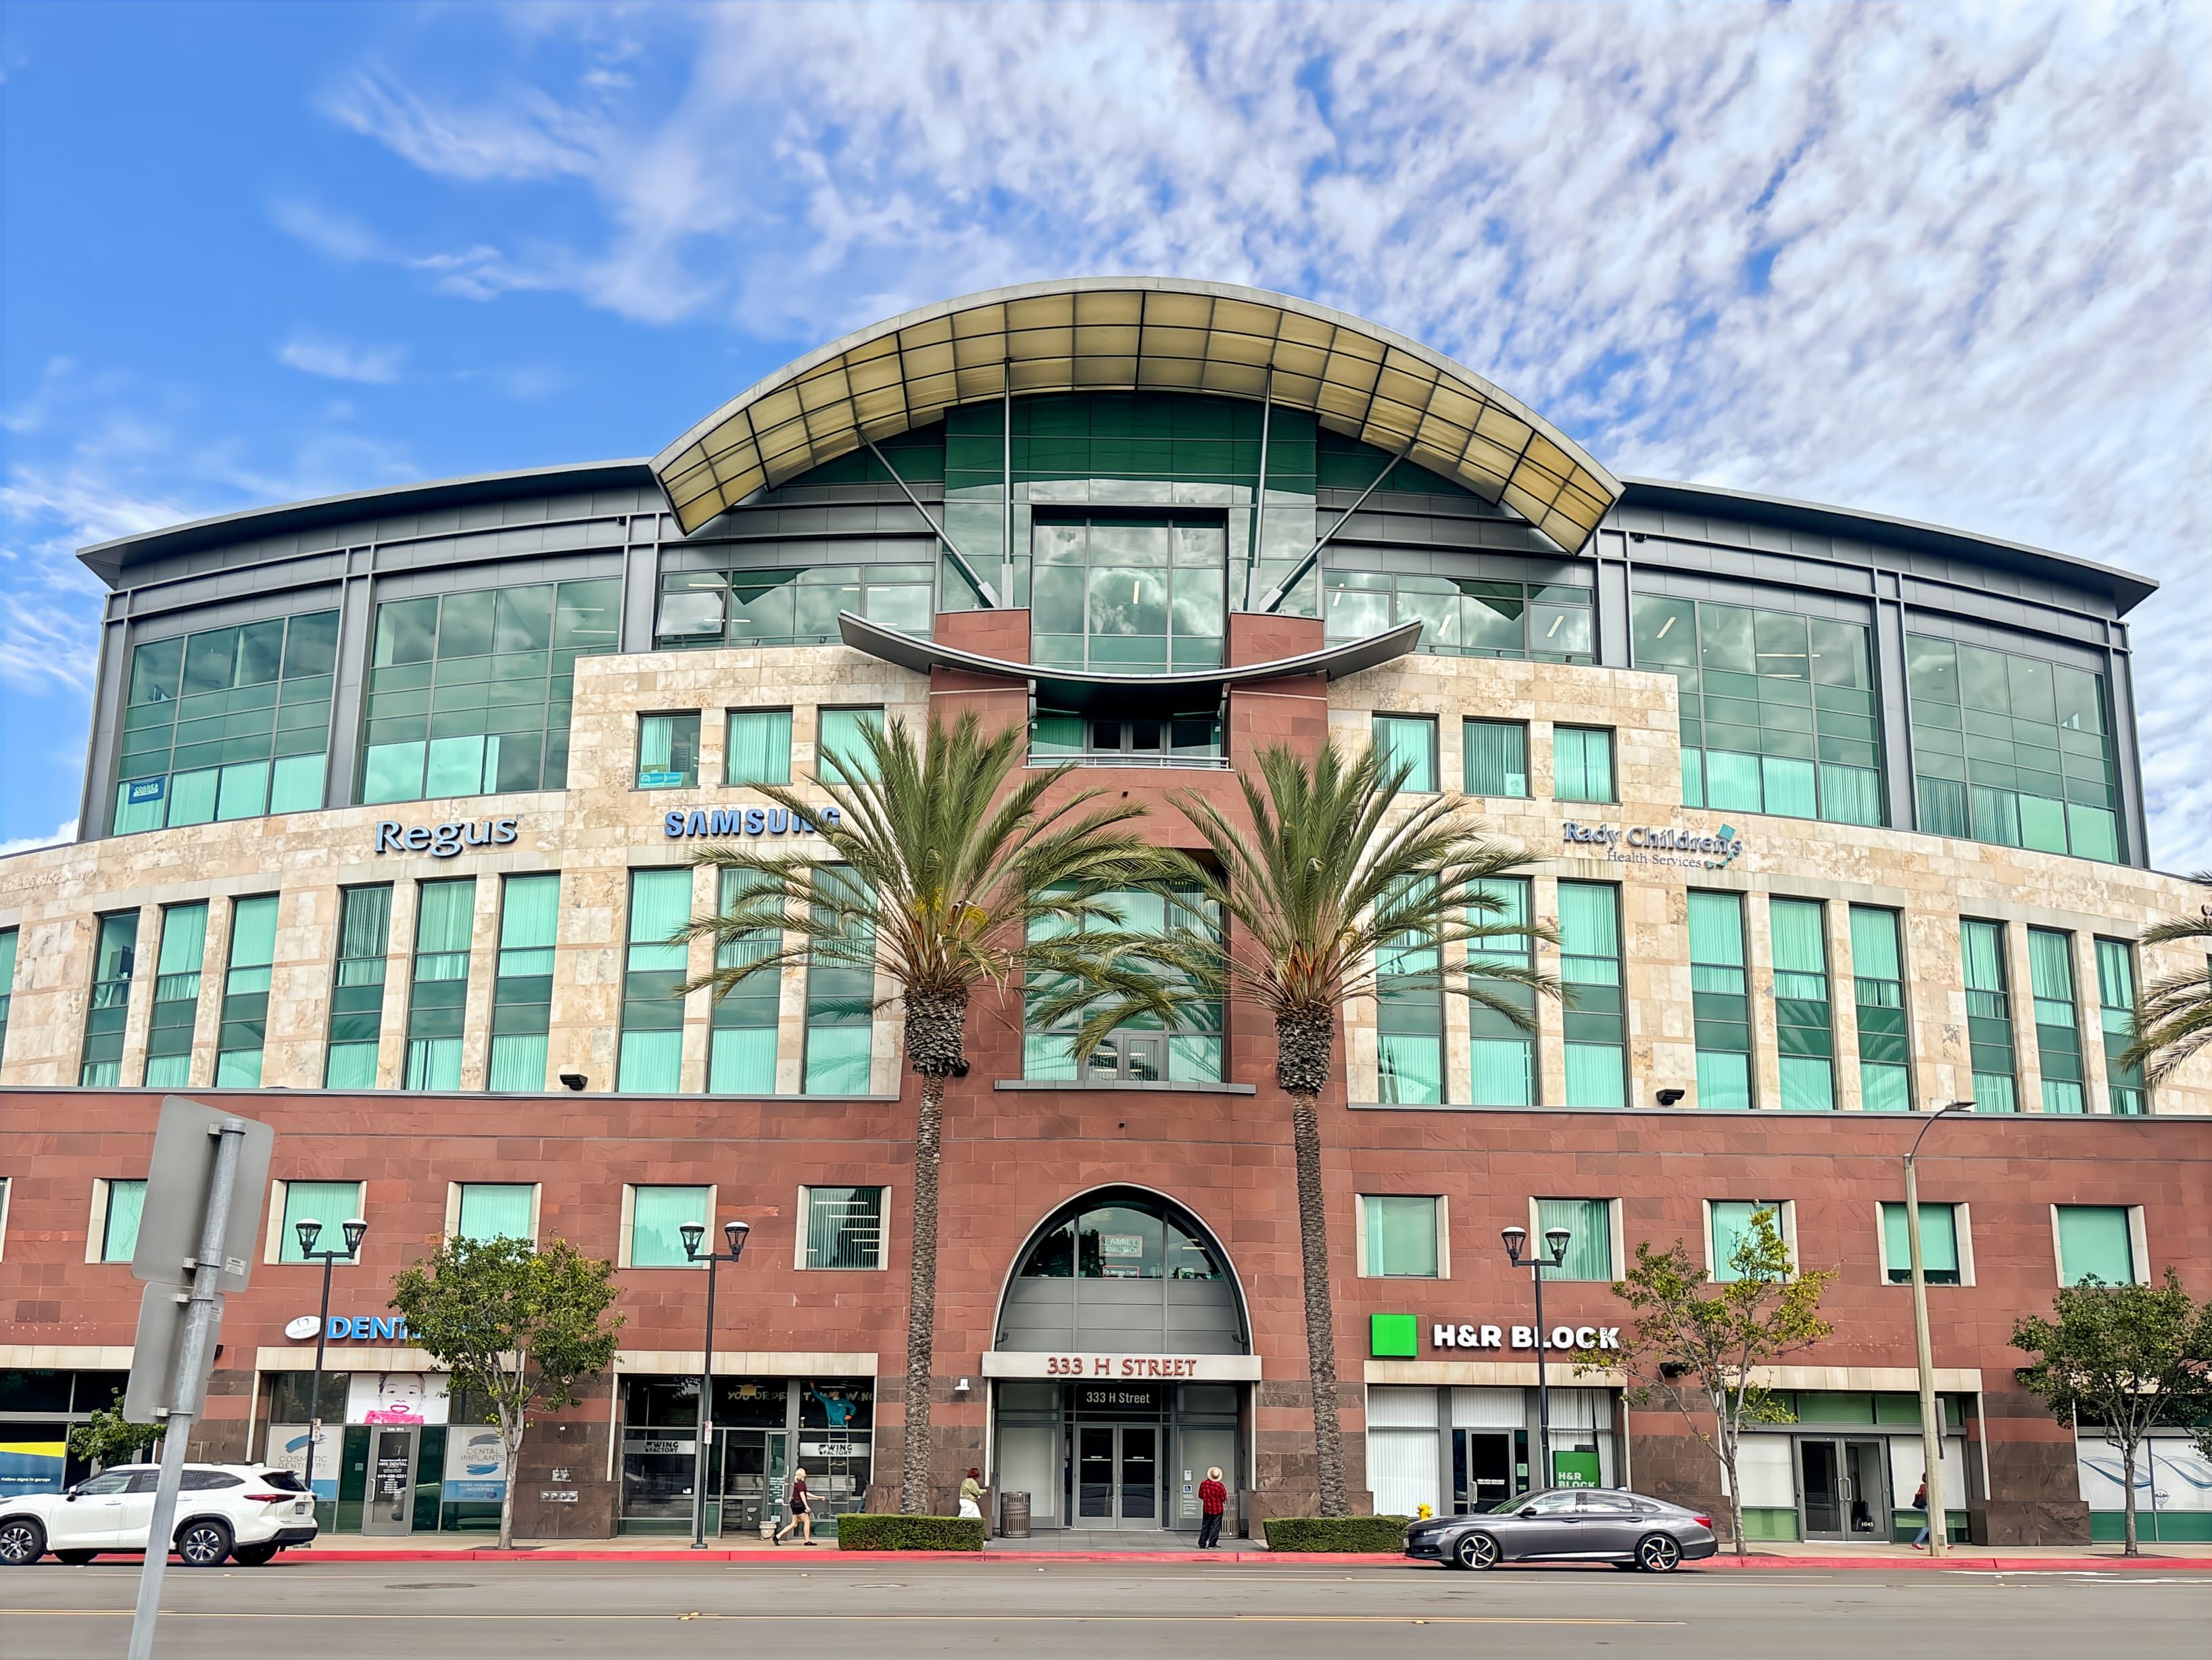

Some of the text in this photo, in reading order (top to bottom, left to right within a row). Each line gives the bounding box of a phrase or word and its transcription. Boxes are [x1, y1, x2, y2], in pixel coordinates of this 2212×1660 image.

[375, 818, 519, 858] Regus
[1564, 822, 1622, 850] Rady
[1607, 851, 1702, 868] Health Services
[1434, 1324, 1620, 1349] H&R BLOCK
[1048, 1356, 1197, 1376] 333 H STREET
[1086, 1392, 1150, 1403] 333 H Street
[1558, 1472, 1582, 1480] H&R
